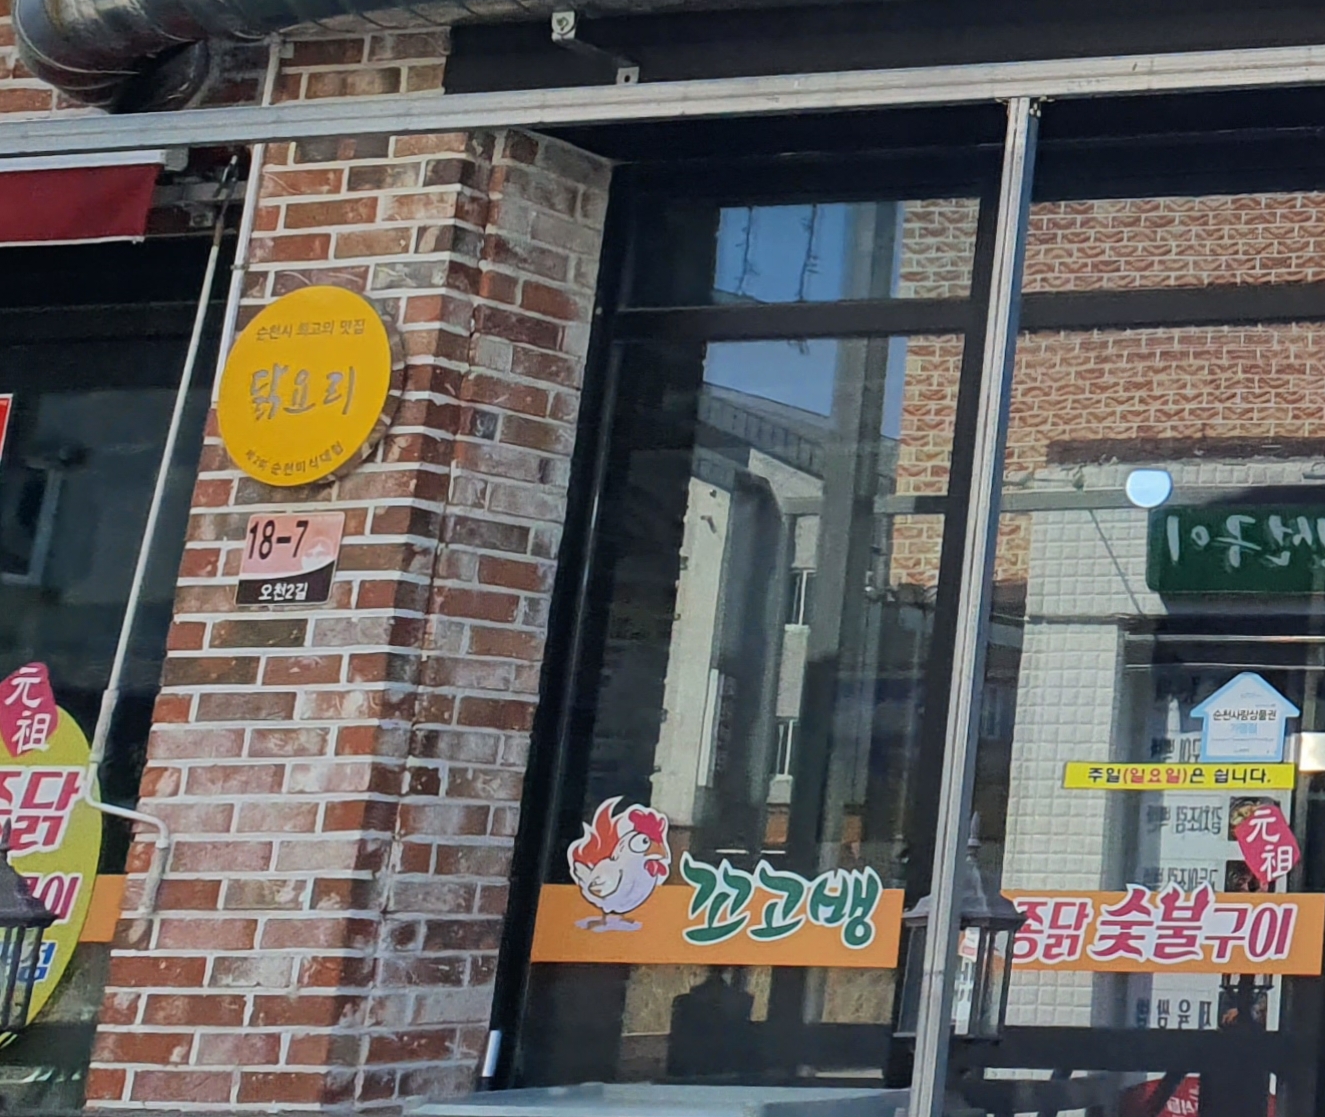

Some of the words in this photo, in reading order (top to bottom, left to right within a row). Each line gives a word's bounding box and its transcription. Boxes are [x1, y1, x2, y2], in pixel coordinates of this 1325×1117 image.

[250, 363, 356, 421] 닭요리
[248, 520, 309, 560] 18-7
[258, 582, 309, 601] 오천2길
[5, 666, 53, 753] 元祖
[1088, 767, 1206, 784] 주일(일요일)은
[1213, 767, 1272, 783] 쉽니다.
[1246, 808, 1294, 882] 元祖
[1011, 901, 1089, 960] 종닭
[1089, 887, 1293, 960] 숯불구이
